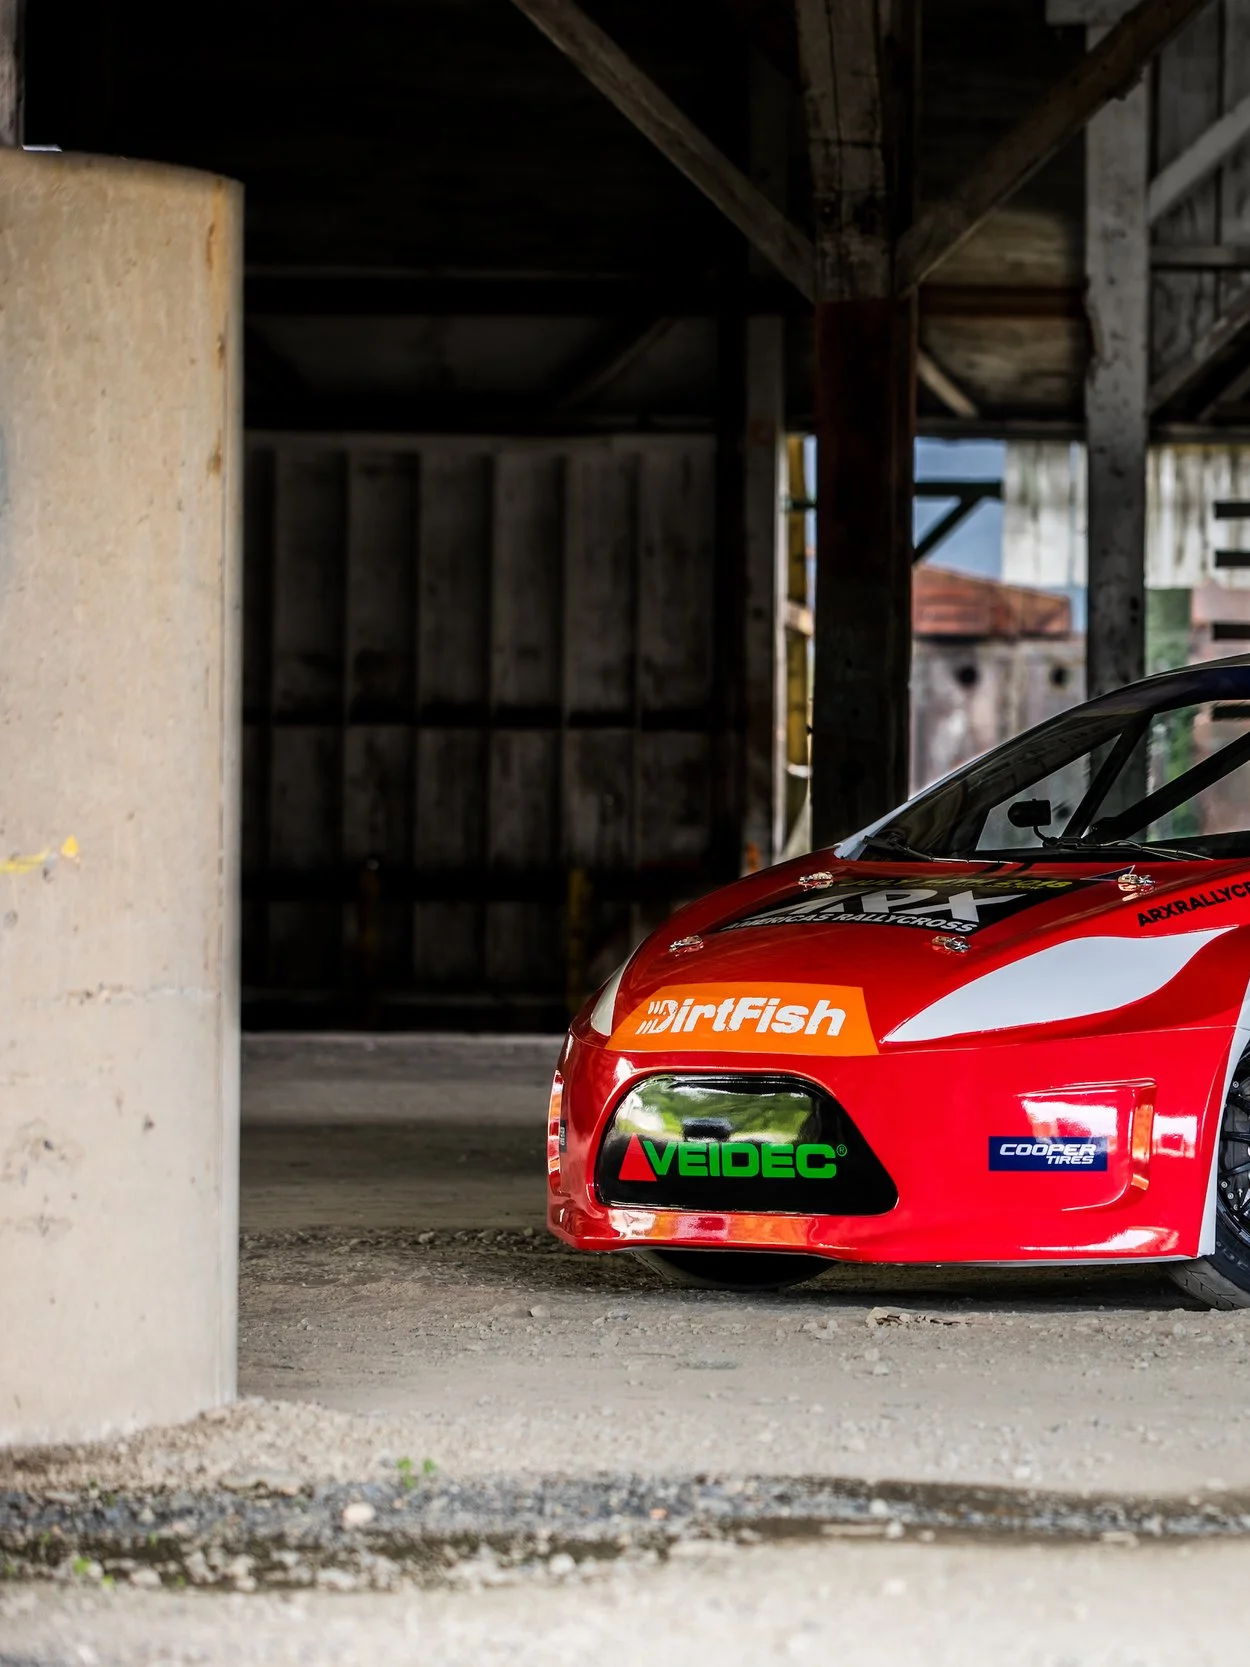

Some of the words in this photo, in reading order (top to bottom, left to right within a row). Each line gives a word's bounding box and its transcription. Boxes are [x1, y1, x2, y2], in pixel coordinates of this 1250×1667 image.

[720, 913, 833, 931] AMERICAS
[834, 913, 978, 933] RALLYCROSS
[635, 997, 846, 1036] DirtFish
[1000, 1144, 1097, 1156] COOPER
[1046, 1155, 1095, 1164] TIRES
